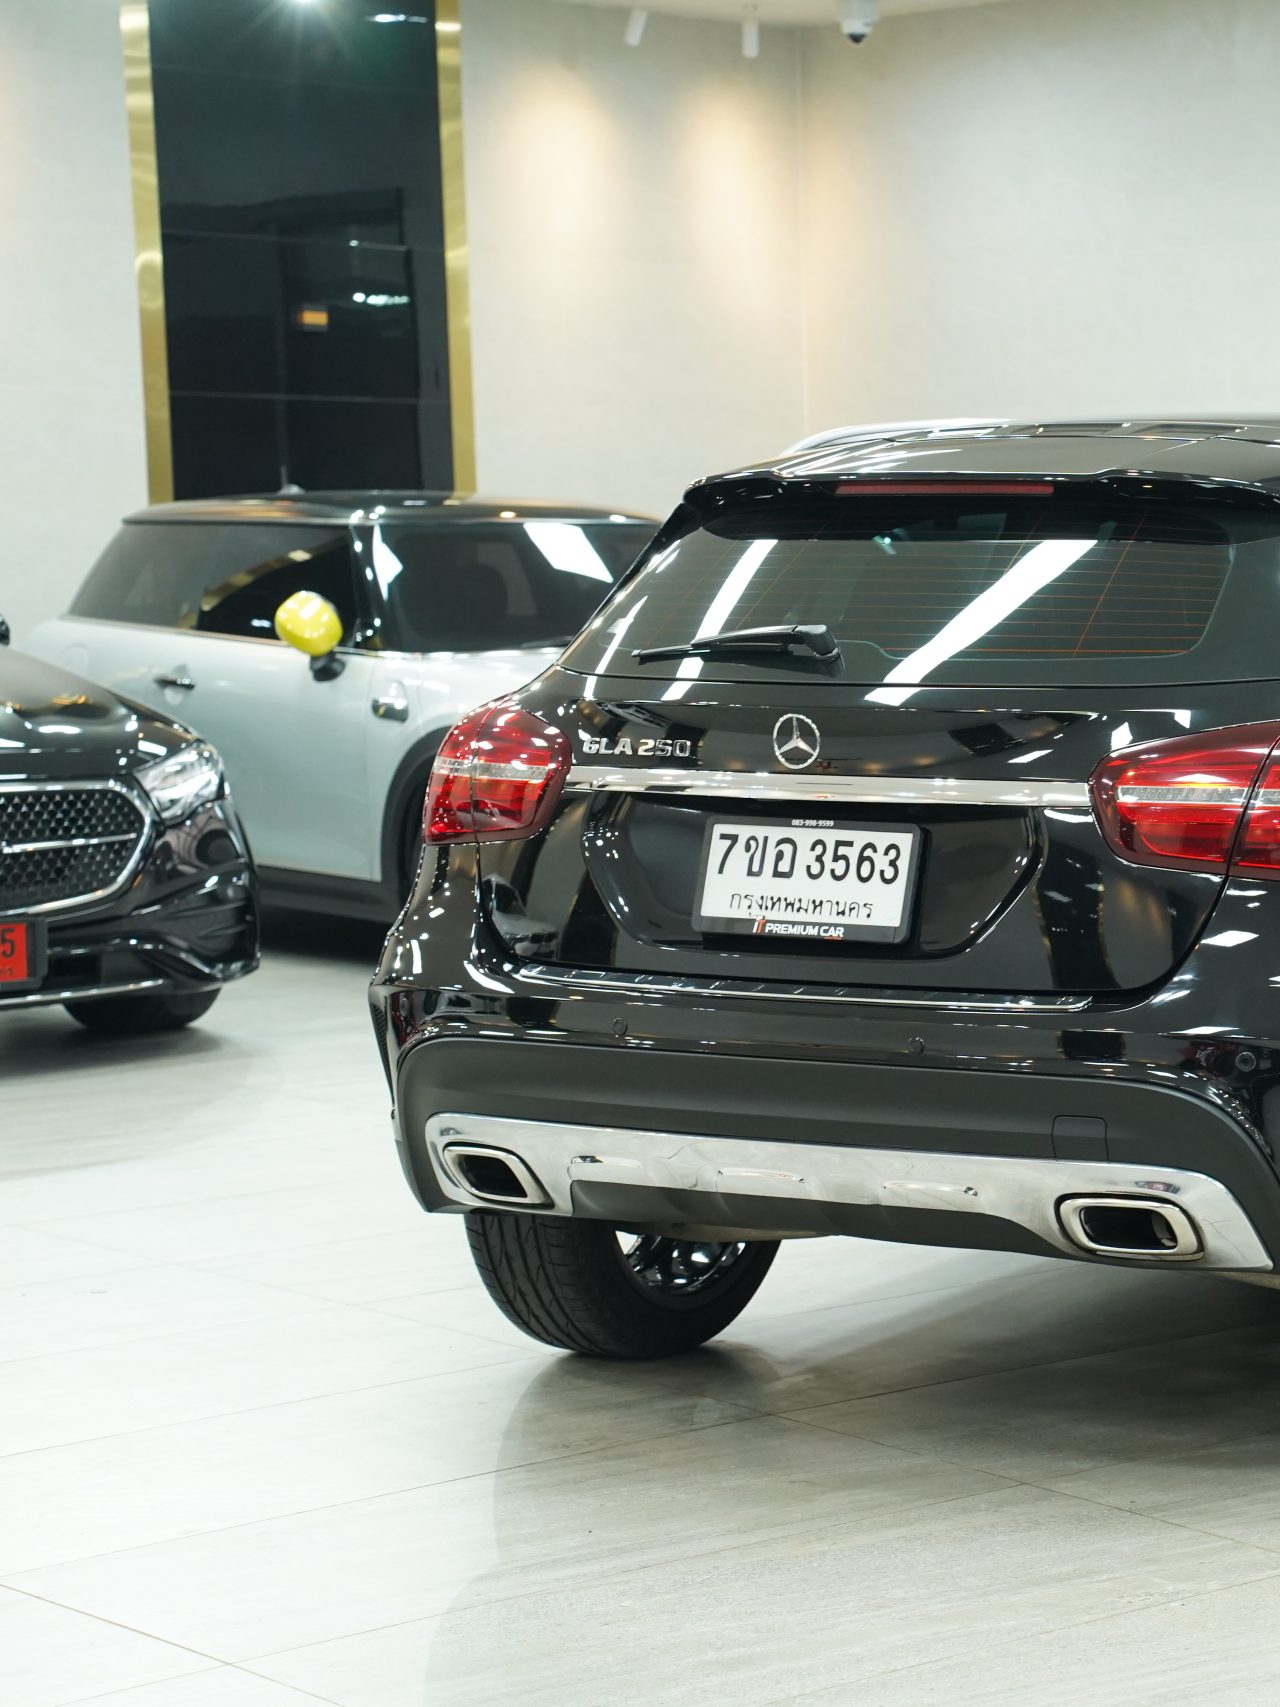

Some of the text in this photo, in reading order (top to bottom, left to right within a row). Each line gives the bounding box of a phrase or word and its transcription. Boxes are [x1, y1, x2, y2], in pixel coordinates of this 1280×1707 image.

[583, 737, 691, 757] GLA 250
[806, 839, 901, 884] 3563
[729, 893, 873, 920] กรุงเทพมหานคร
[765, 923, 820, 936] PREMIUM
[819, 926, 844, 937] CAR
